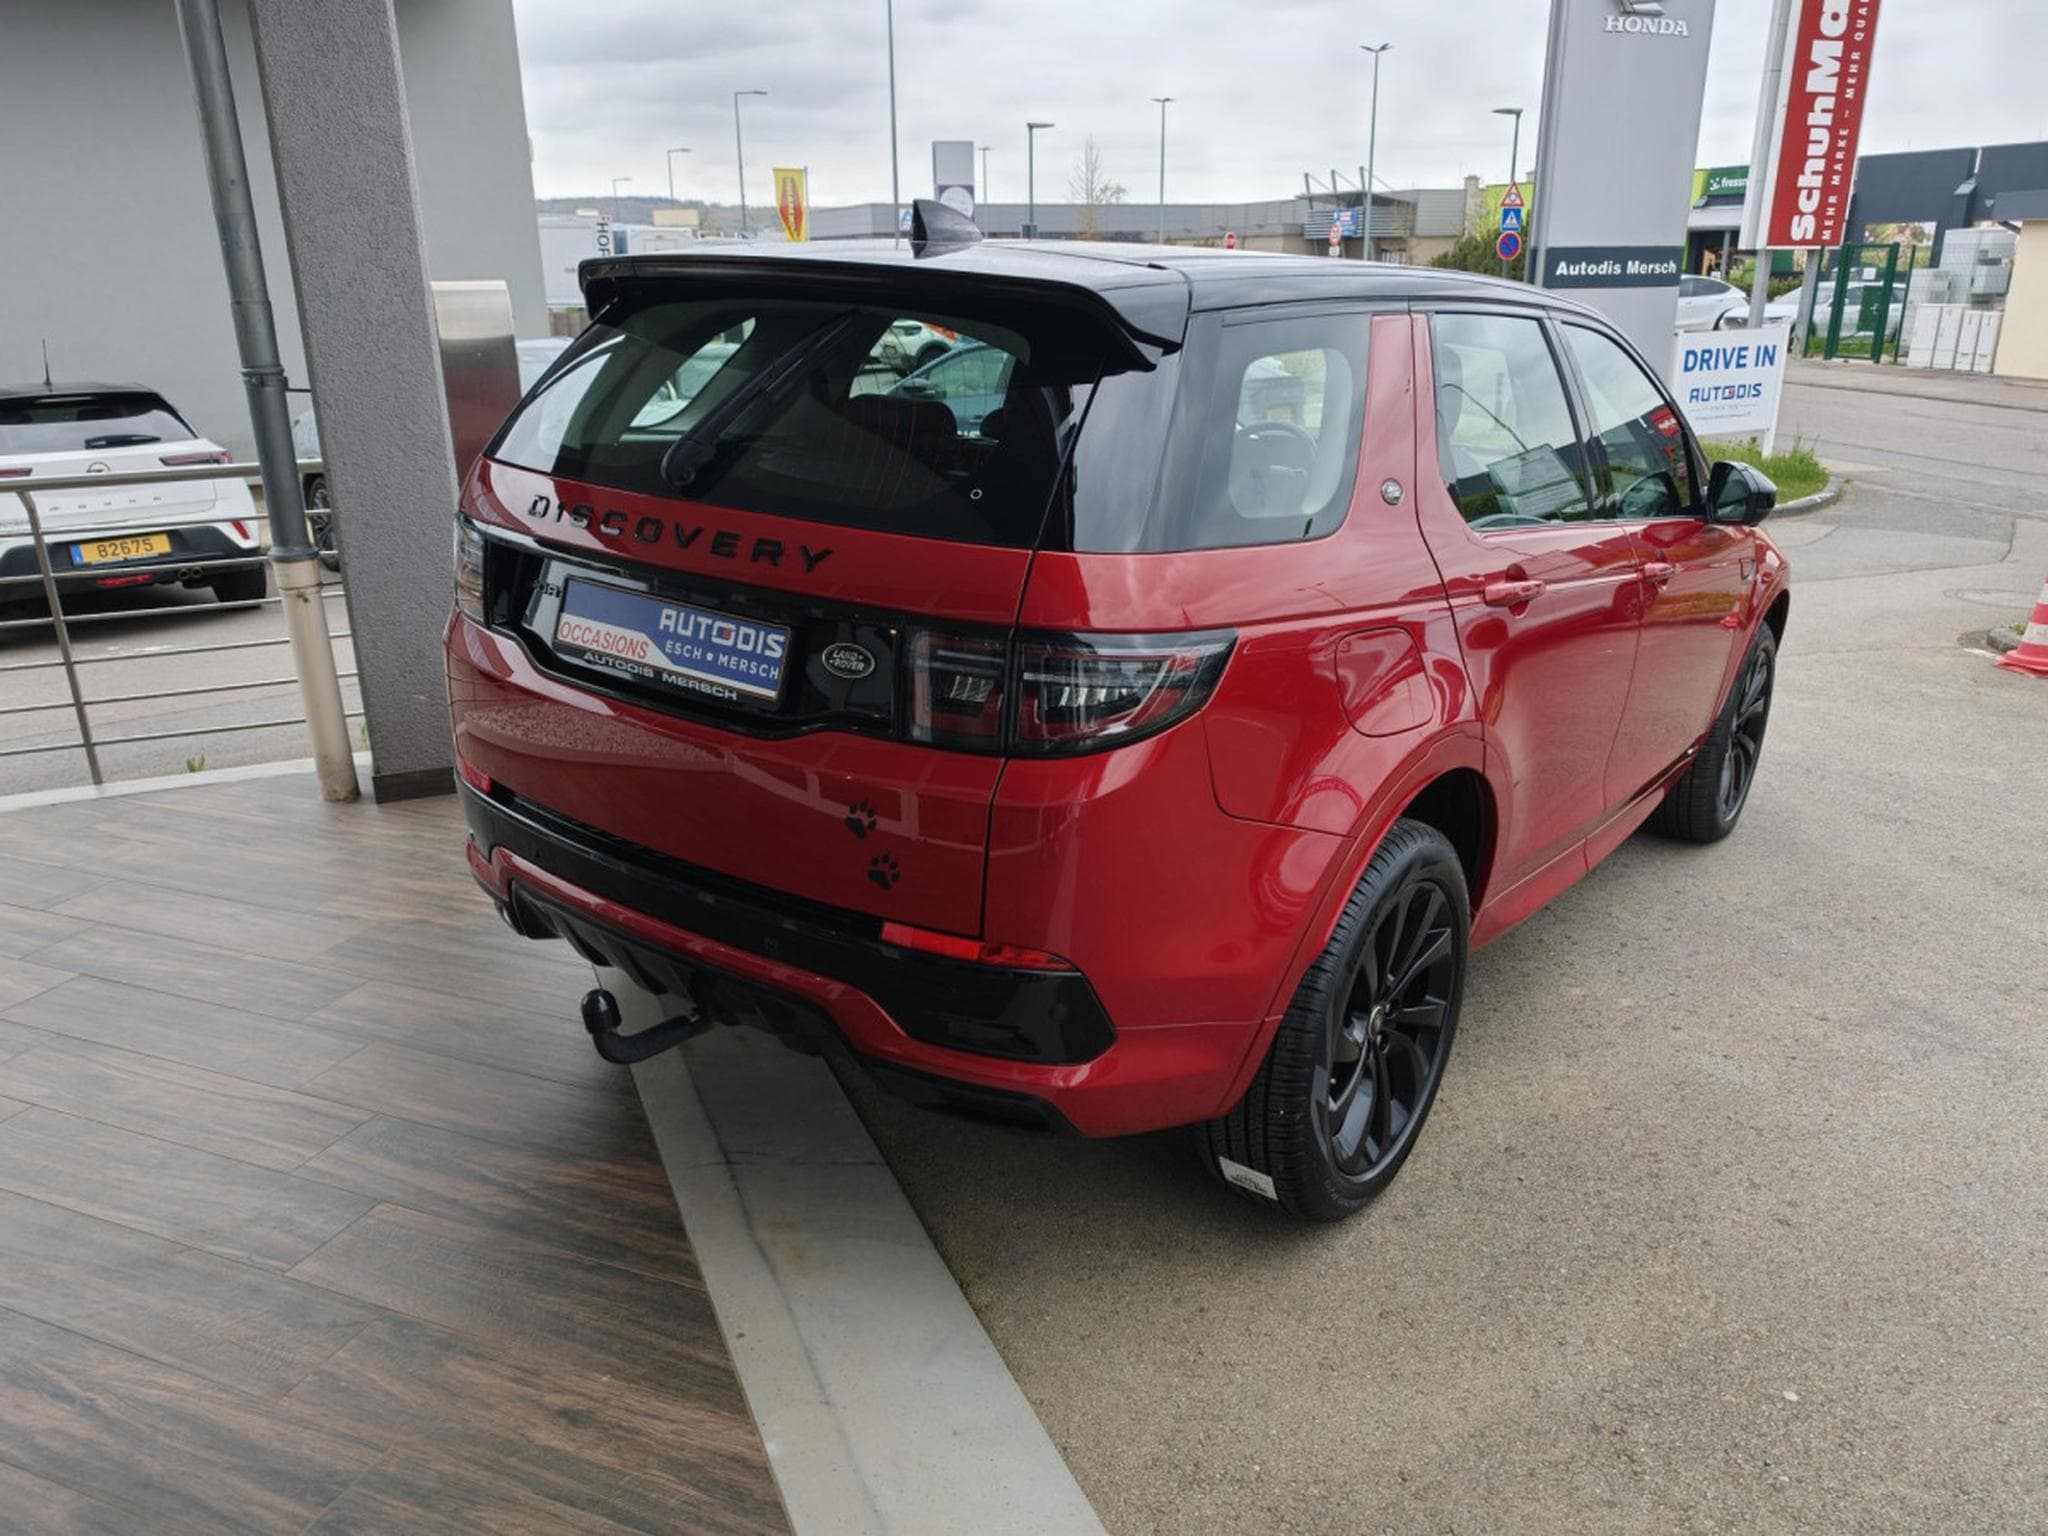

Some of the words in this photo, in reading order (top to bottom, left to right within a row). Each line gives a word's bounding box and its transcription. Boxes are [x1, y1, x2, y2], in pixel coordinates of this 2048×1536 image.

[1604, 15, 1689, 37] HONDA
[1821, 195, 1838, 240] MEHR
[1831, 128, 1849, 186] MARKE
[1845, 51, 1861, 99] MEHR
[1555, 260, 1622, 276] Autodis
[1626, 260, 1677, 275] Mersch
[1683, 346, 1749, 373] DRIVE
[1754, 344, 1777, 368] IN
[1689, 383, 1762, 403] AUTODIS
[97, 538, 154, 559] 82675
[528, 494, 833, 573] DISCOVERY
[560, 621, 650, 660] OCCASIONS
[659, 608, 786, 659] AUTODIS
[582, 652, 655, 678] AUTODIS
[661, 673, 738, 700] MERSCH
[665, 640, 703, 661] ESCH
[718, 653, 780, 680] MERSCH
